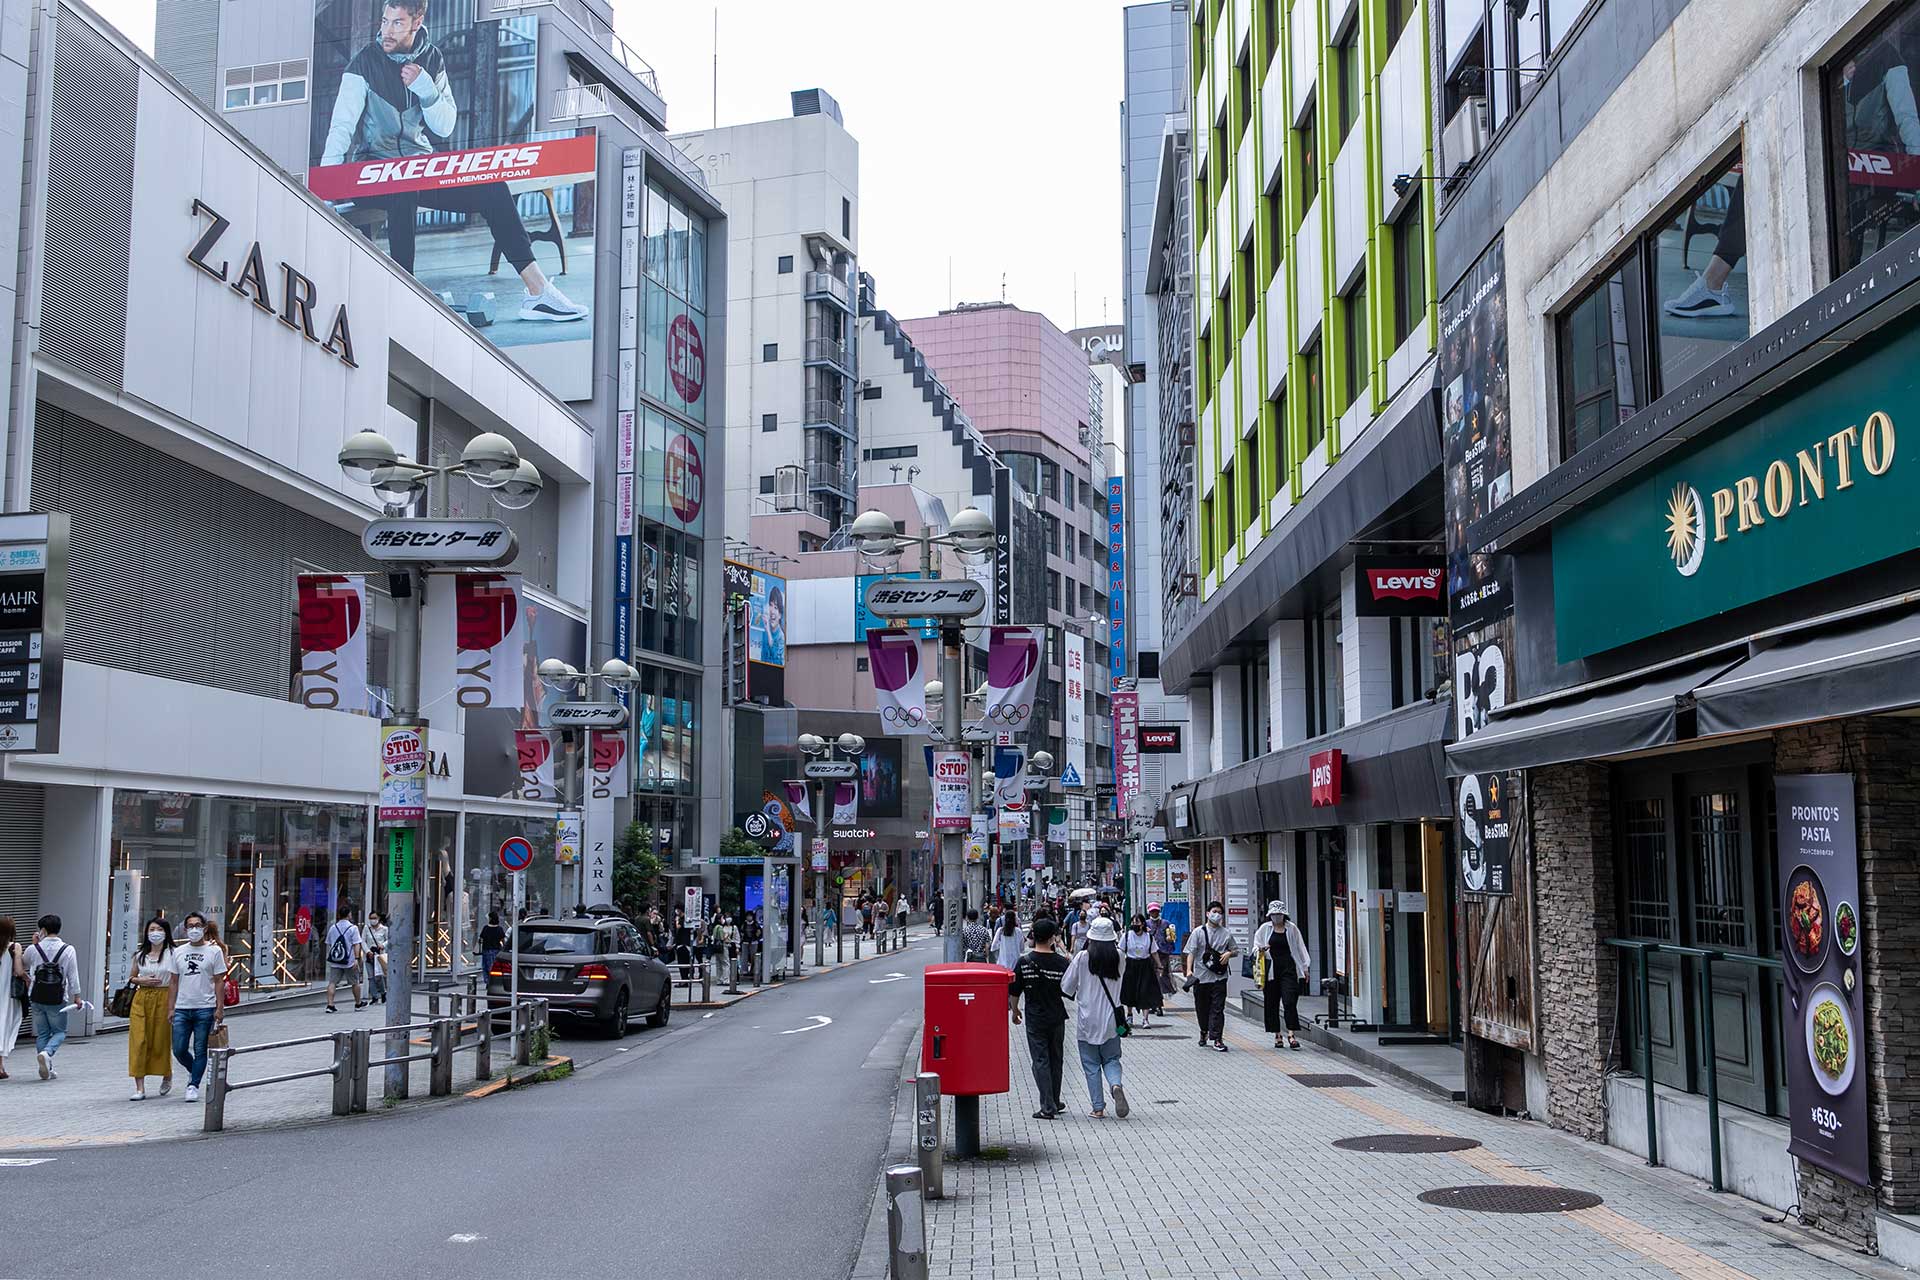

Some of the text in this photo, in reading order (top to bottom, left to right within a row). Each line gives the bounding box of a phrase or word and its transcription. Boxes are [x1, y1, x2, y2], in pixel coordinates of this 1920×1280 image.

[357, 146, 542, 185] SKECHERS
[457, 172, 499, 183] MEMORY
[501, 169, 530, 178] FOAM
[187, 198, 360, 368] ZARA
[669, 455, 700, 503] Labo
[1711, 411, 1895, 541] PRONTO
[370, 531, 503, 547] 渋谷センター街
[998, 534, 1008, 624] SAKAZE
[872, 589, 977, 604] 渋谷センター街
[30, 672, 38, 680] 2F
[552, 708, 620, 718] 渋谷センター街
[386, 738, 420, 756] STOP
[393, 761, 419, 773] 実施中
[517, 748, 541, 799] 2020
[592, 747, 612, 799] 2020
[939, 763, 967, 775] STOP
[947, 784, 967, 792] 実施中
[1791, 806, 1840, 821] PRONTO'S
[833, 829, 869, 838] swatch
[1801, 826, 1831, 842] PASTA
[592, 842, 604, 892] ZARA
[204, 905, 224, 914] ZARA
[260, 878, 268, 967] SALE
